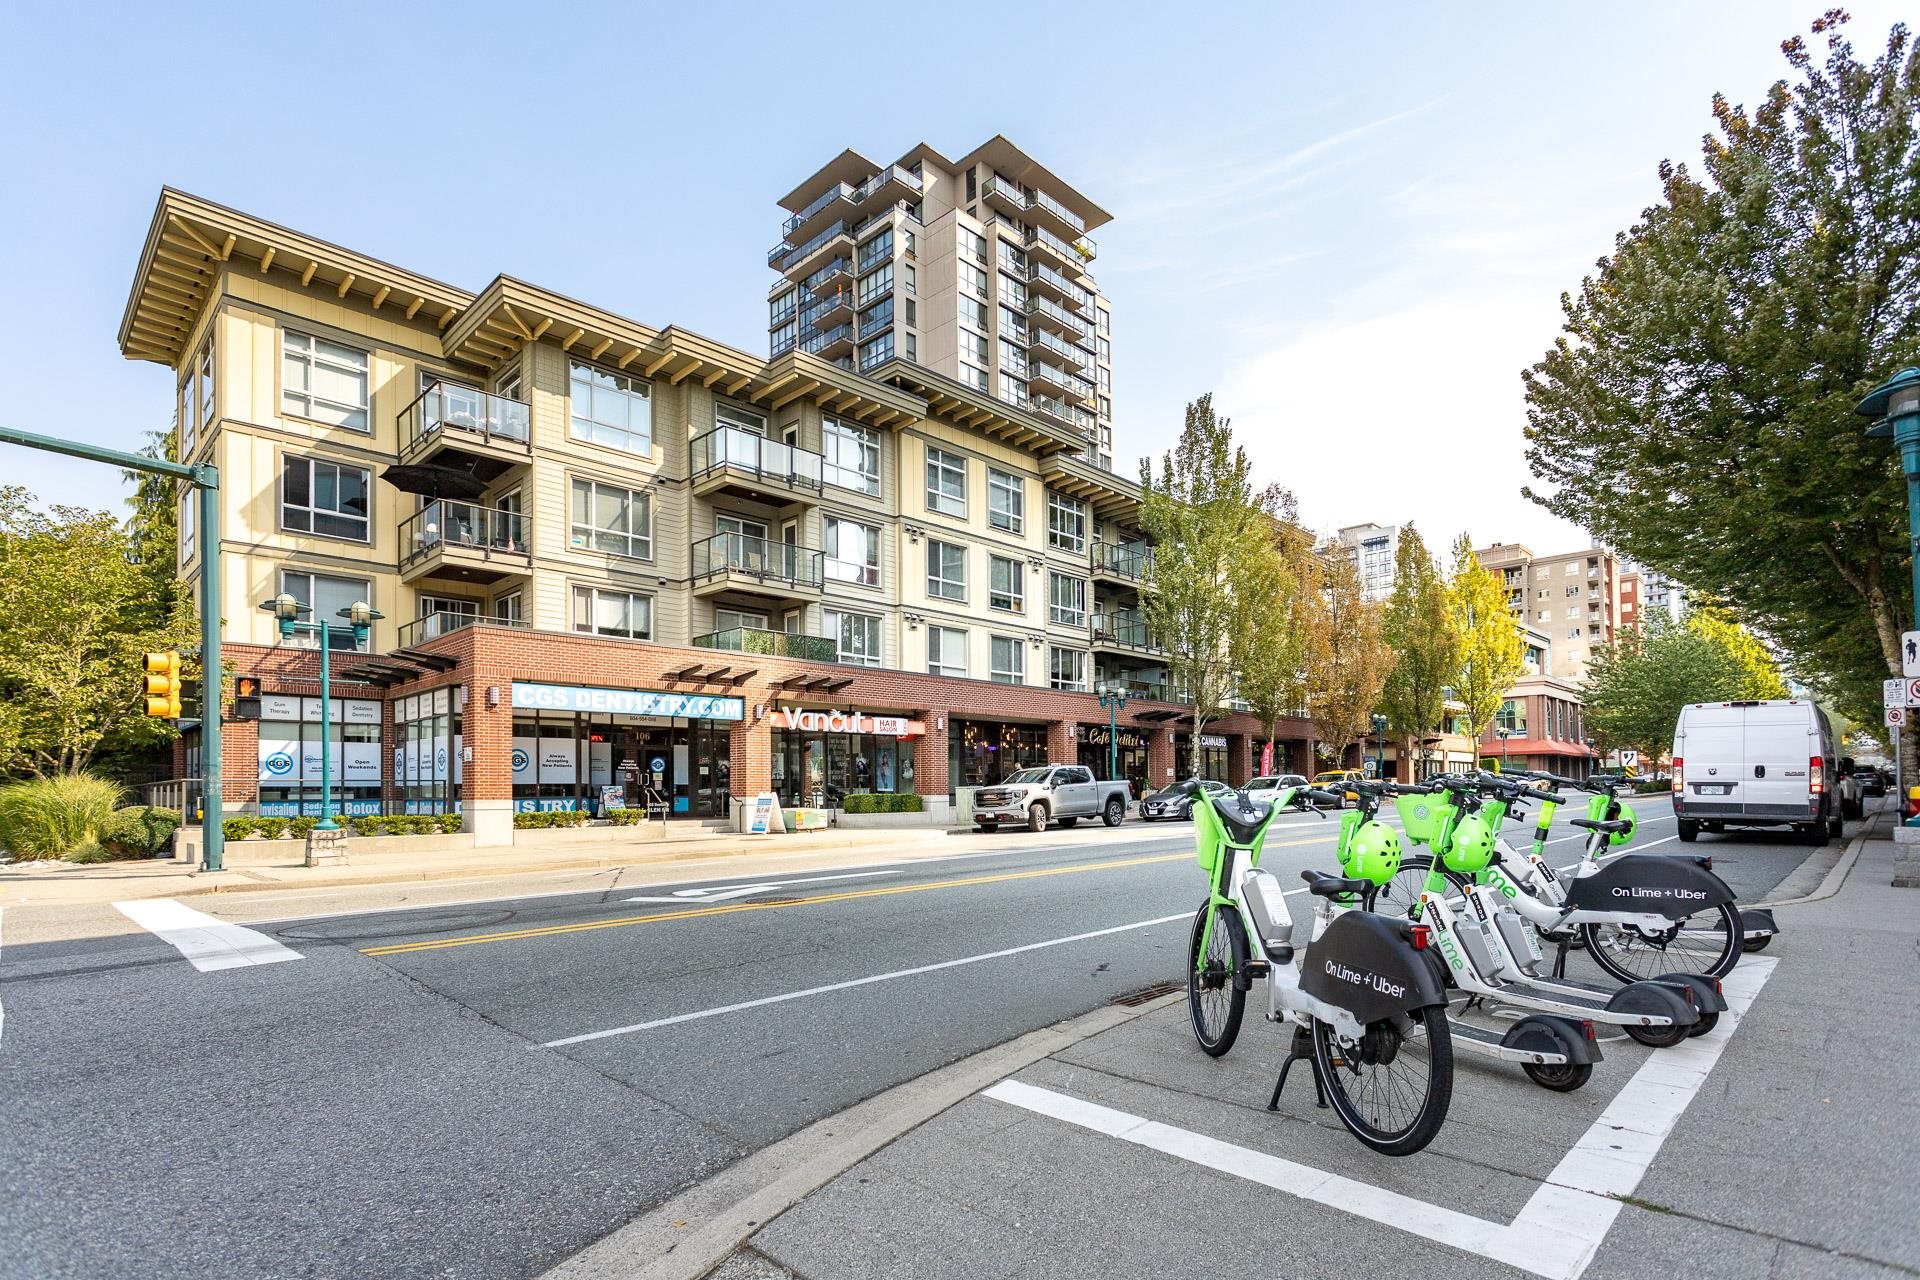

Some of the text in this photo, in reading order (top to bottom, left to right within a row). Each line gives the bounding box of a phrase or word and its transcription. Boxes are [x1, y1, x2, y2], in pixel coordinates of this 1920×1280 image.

[518, 685, 740, 717] CGS DENTISTRY.COM
[269, 708, 290, 716] Therapy
[782, 705, 866, 733] Vancut
[880, 719, 897, 727] HAIR
[636, 731, 651, 741] 106
[1201, 736, 1227, 747] CANNABIS
[268, 757, 291, 768] CGS
[260, 802, 299, 816] Invisalign
[345, 802, 380, 815] Botox
[1488, 870, 1517, 900] me
[1612, 887, 1630, 897] On
[1631, 887, 1662, 898] Lime
[1674, 888, 1707, 900] Uber
[1438, 930, 1464, 970] Lime
[1325, 960, 1337, 976] On
[1336, 963, 1361, 985] Lime
[1373, 975, 1406, 999] Uber
